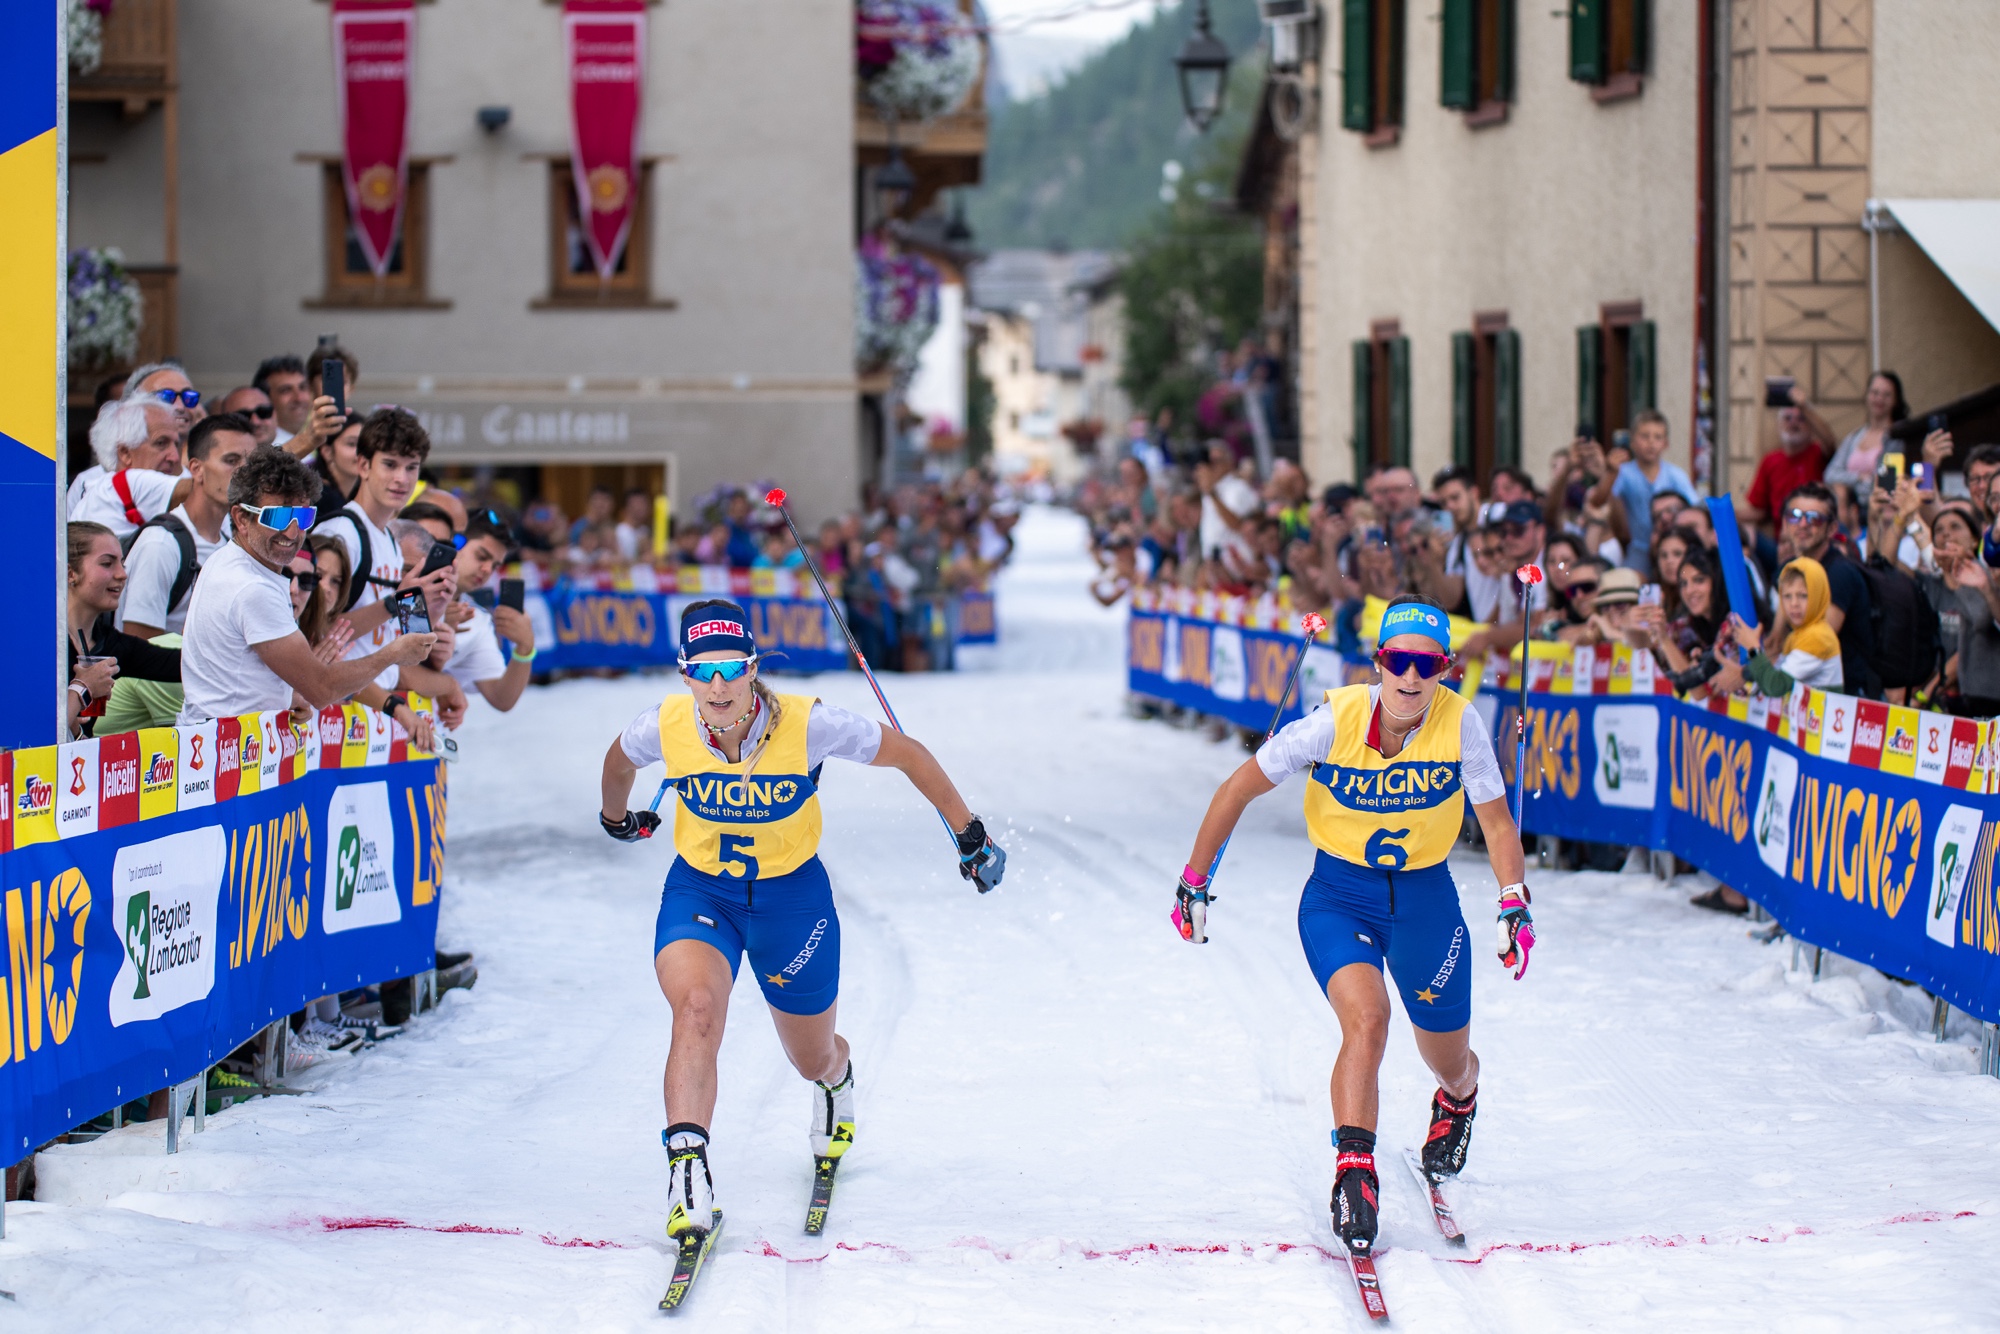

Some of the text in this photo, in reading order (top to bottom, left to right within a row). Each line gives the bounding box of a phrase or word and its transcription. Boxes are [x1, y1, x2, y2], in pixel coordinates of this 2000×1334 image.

[481, 405, 629, 446] Cantoni
[690, 622, 743, 642] SCAME
[102, 759, 137, 803] felicetti
[1356, 796, 1427, 807] feel the alps
[62, 806, 91, 822] GARMONT
[699, 804, 770, 818] feel the alps
[718, 832, 760, 881] 5
[1364, 828, 1411, 871] 6
[1792, 766, 1921, 919] LIVIGNO
[151, 899, 191, 941] Regione
[149, 931, 201, 976] Lombardia
[782, 917, 829, 977] ESERCITO
[1431, 925, 1464, 989] ESERCITO
